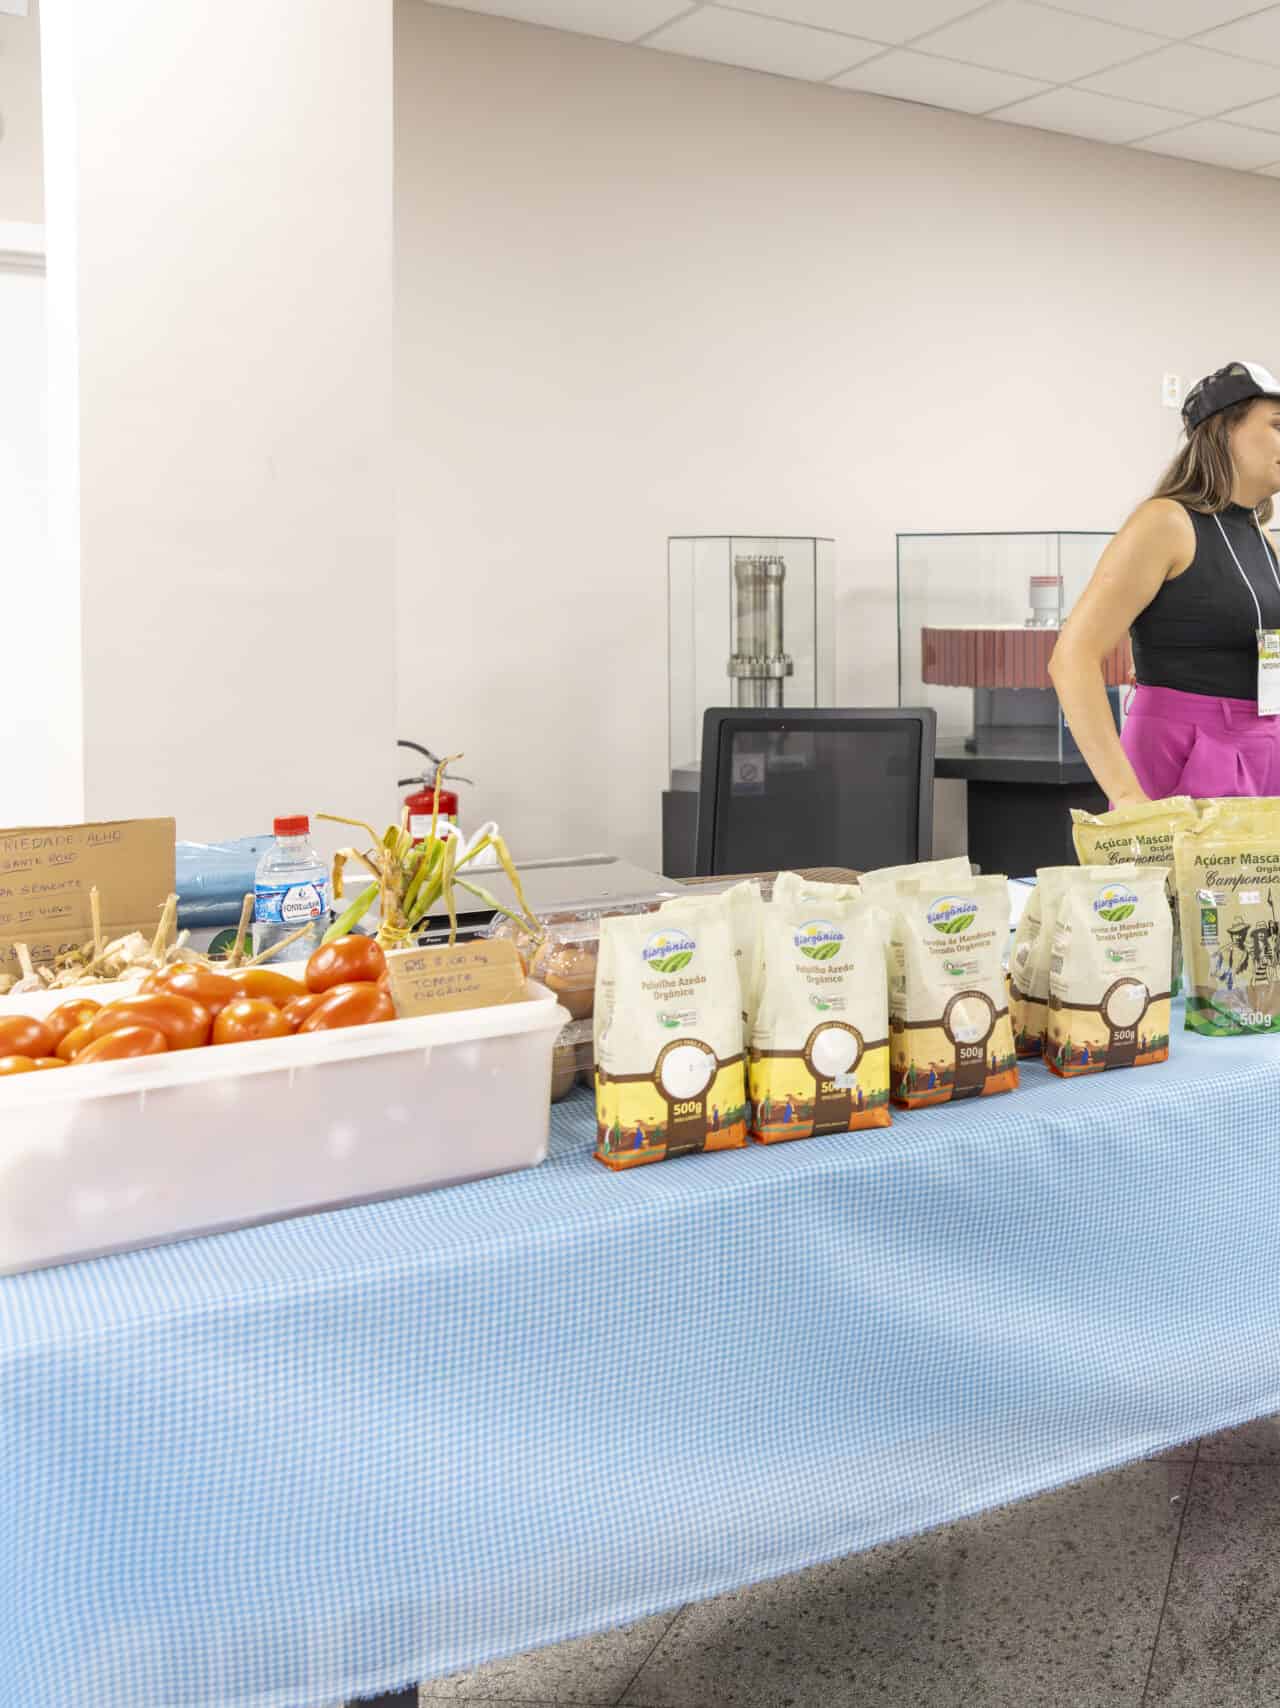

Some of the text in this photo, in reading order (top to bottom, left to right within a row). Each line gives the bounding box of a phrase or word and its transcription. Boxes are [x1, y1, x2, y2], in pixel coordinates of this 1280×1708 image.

[1094, 838, 1133, 852] Açúcar
[1194, 854, 1237, 868] Açúcar
[1240, 1011, 1272, 1027] 500g
[1113, 1029, 1135, 1041] 500g
[959, 1047, 984, 1059] 500g
[821, 1081, 847, 1094] 50
[673, 1101, 702, 1117] 500g
